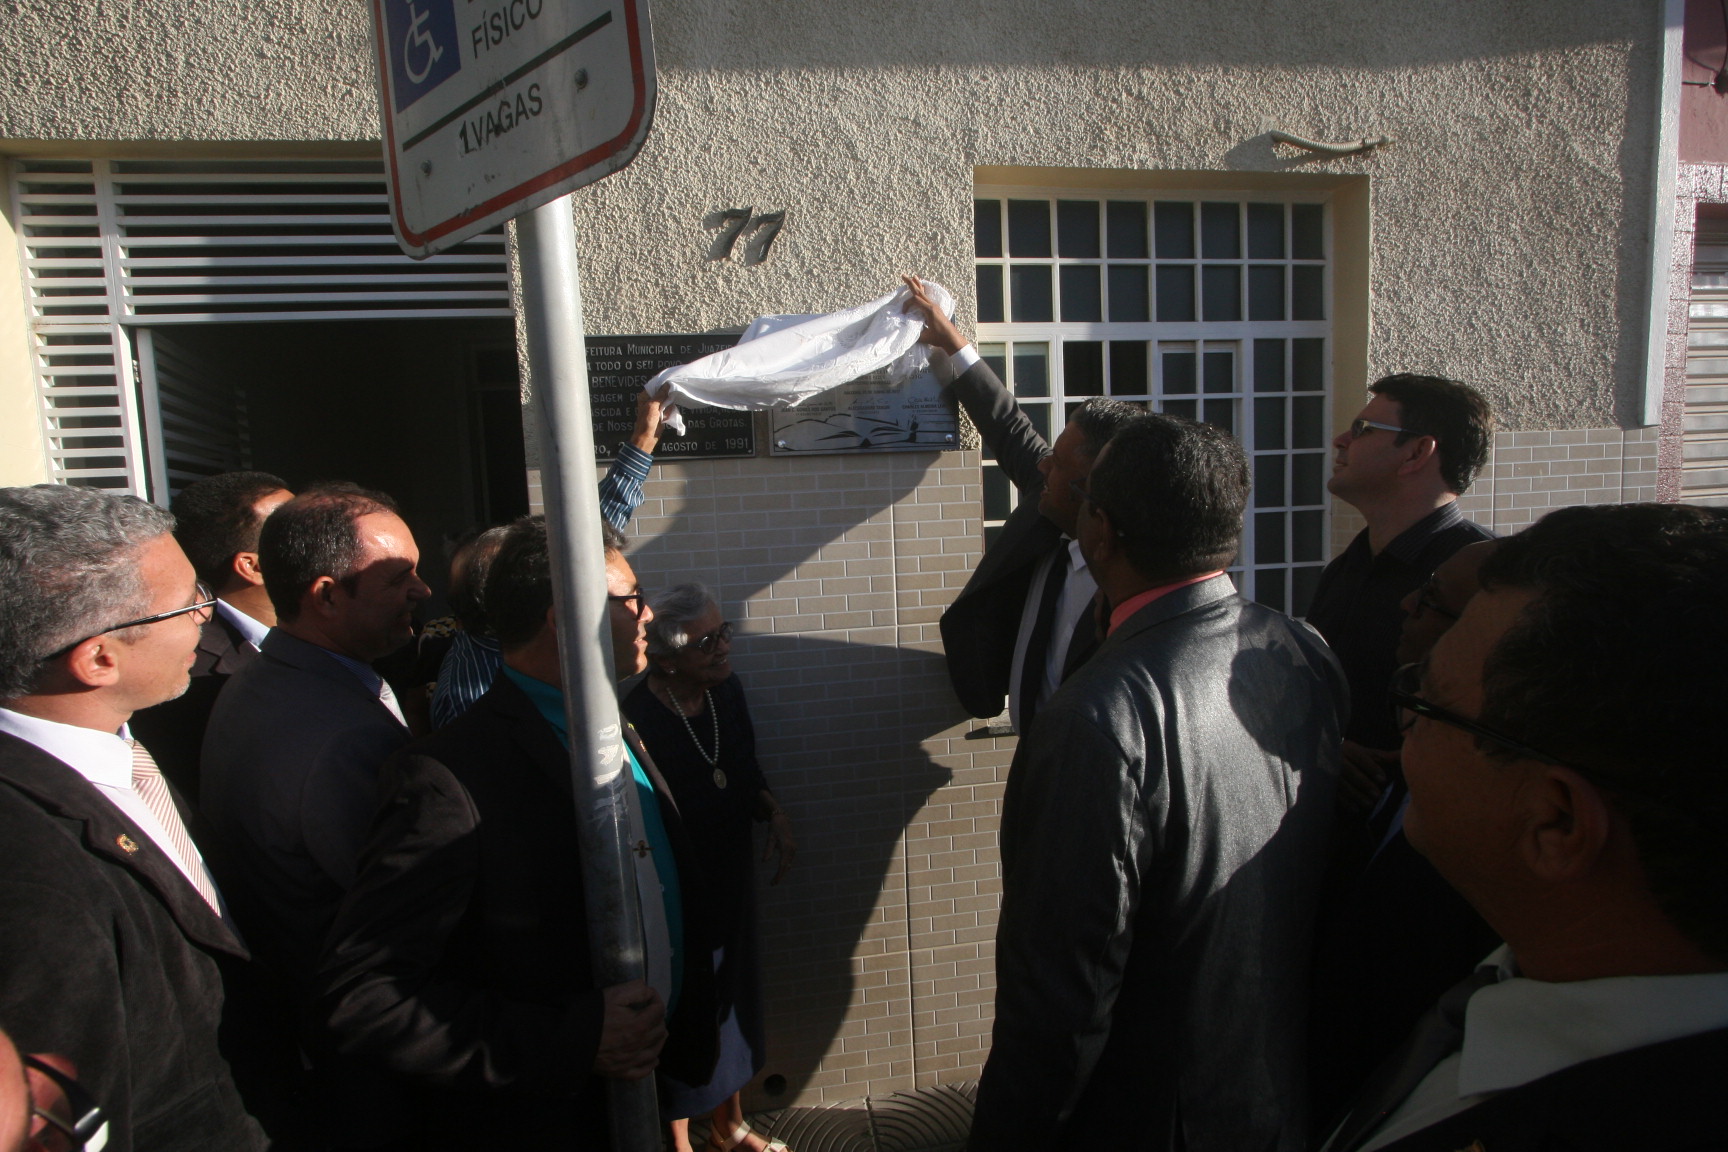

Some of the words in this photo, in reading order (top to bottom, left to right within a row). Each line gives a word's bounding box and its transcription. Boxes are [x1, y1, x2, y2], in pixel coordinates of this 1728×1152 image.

[721, 205, 786, 262] 77
[585, 346, 623, 356] FEITURA
[680, 346, 692, 354] DE
[595, 361, 621, 371] TODO
[625, 360, 633, 370] O
[636, 360, 654, 370] SEU
[591, 375, 648, 388] BENEVIDES
[590, 393, 623, 403] SAGEM
[591, 407, 622, 417] SCIDA
[607, 420, 634, 432] NOSS
[687, 420, 706, 429] DAS
[661, 441, 698, 452] AGOSTO
[704, 441, 717, 450] DE
[725, 437, 749, 450] 1991
